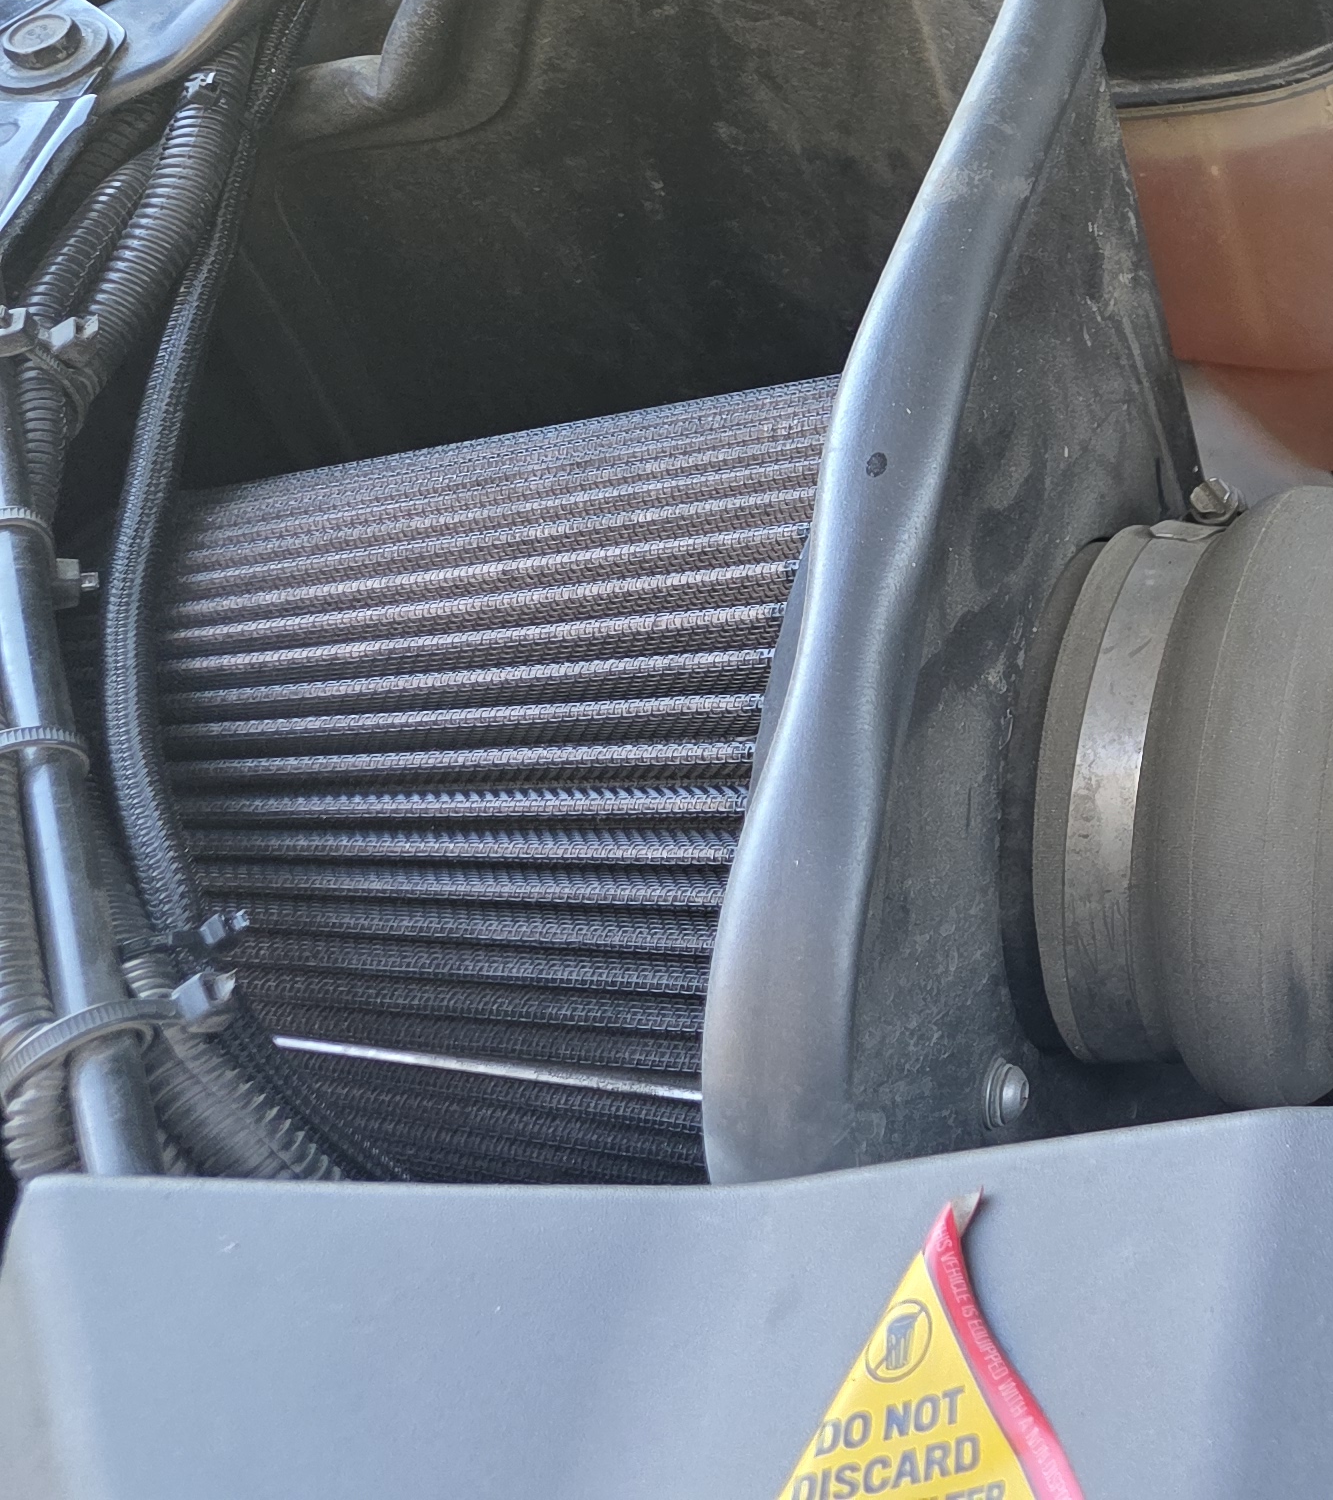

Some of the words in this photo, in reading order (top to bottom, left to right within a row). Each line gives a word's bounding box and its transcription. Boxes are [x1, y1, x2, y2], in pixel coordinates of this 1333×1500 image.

[939, 1249, 969, 1305] VEHICLE
[960, 1300, 978, 1319] IS
[968, 1317, 1009, 1381] EQUIPPED
[814, 1409, 873, 1459] DO
[882, 1385, 966, 1442] NOT
[996, 1377, 1028, 1416] WITH
[790, 1432, 981, 1500] DISCARD
